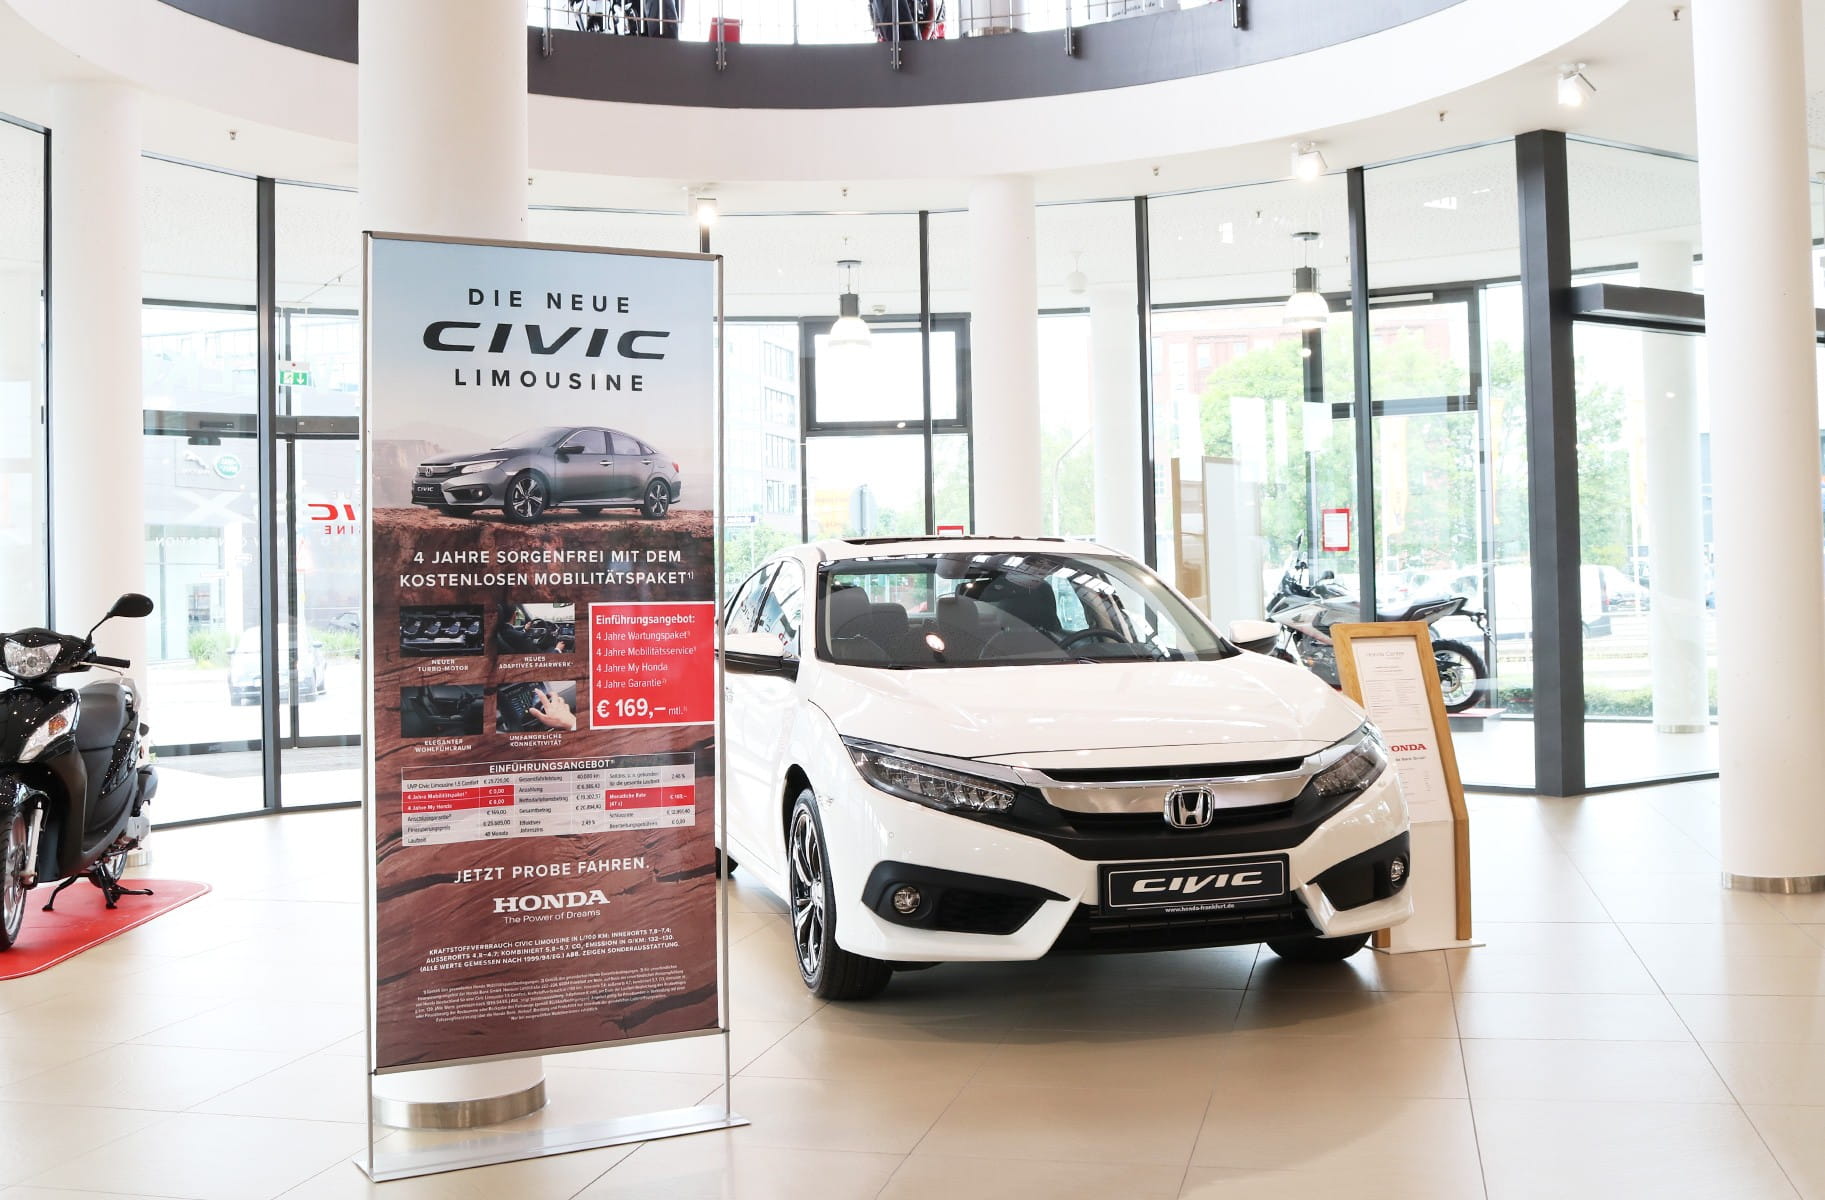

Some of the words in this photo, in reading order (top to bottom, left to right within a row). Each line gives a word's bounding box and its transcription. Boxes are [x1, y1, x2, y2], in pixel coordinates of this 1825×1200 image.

[469, 288, 522, 307] DIE
[547, 293, 629, 313] NEUE
[423, 321, 670, 360] CIVIC
[455, 369, 643, 392] LIMOUSINE
[414, 552, 424, 564] 4
[432, 551, 490, 564] JAHRE
[497, 550, 604, 564] SORGENFREI
[611, 550, 640, 562] MIT
[646, 550, 681, 562] DEM
[400, 572, 528, 588] KOSTENLOSEN
[596, 614, 695, 626] Einführungsangebot:
[596, 632, 601, 640] 4
[604, 631, 625, 640] Jahre
[596, 648, 601, 656] 4
[604, 647, 625, 656] Jahre
[431, 658, 455, 666] NEUER
[596, 663, 601, 672] 4
[604, 663, 625, 672] Jahre
[628, 663, 640, 673] My
[642, 663, 668, 672] Honda
[596, 680, 601, 688] 4
[604, 679, 625, 688] Jahre
[597, 699, 610, 718] €
[424, 738, 463, 747] ELEGANTER
[509, 733, 562, 742] UMFANGREICHE
[510, 740, 562, 749] KONNEKTIVITÄT
[1389, 743, 1428, 752] ONDA
[489, 759, 616, 774] EINFÜHRUNGSANGEBOT
[454, 866, 504, 884] JETZT
[512, 862, 571, 879] PROBE
[578, 857, 649, 874] FAHREN.
[1132, 871, 1263, 894] CIVIC
[493, 889, 610, 913] HONDA
[1165, 903, 1235, 913] www.honda-frankfurt.de
[503, 915, 521, 924] The
[523, 913, 553, 924] Power
[554, 911, 565, 921] of
[566, 908, 600, 919] Dreams
[429, 942, 513, 956] KRAFTSTOFFVERBRAUCH
[514, 940, 533, 948] CIVIC
[534, 936, 570, 946] LIMOUSINE
[611, 929, 648, 938] INNERORTS
[420, 964, 438, 973] (ALLE
[439, 962, 462, 970] WERTE
[464, 959, 501, 968] GEMESSEN
[582, 948, 606, 956] ZEIGEN
[607, 941, 680, 954] SONDERAUSSTATTUNG.
[426, 953, 471, 964] AUSSERORTS
[501, 947, 544, 956] KOMBINIERT
